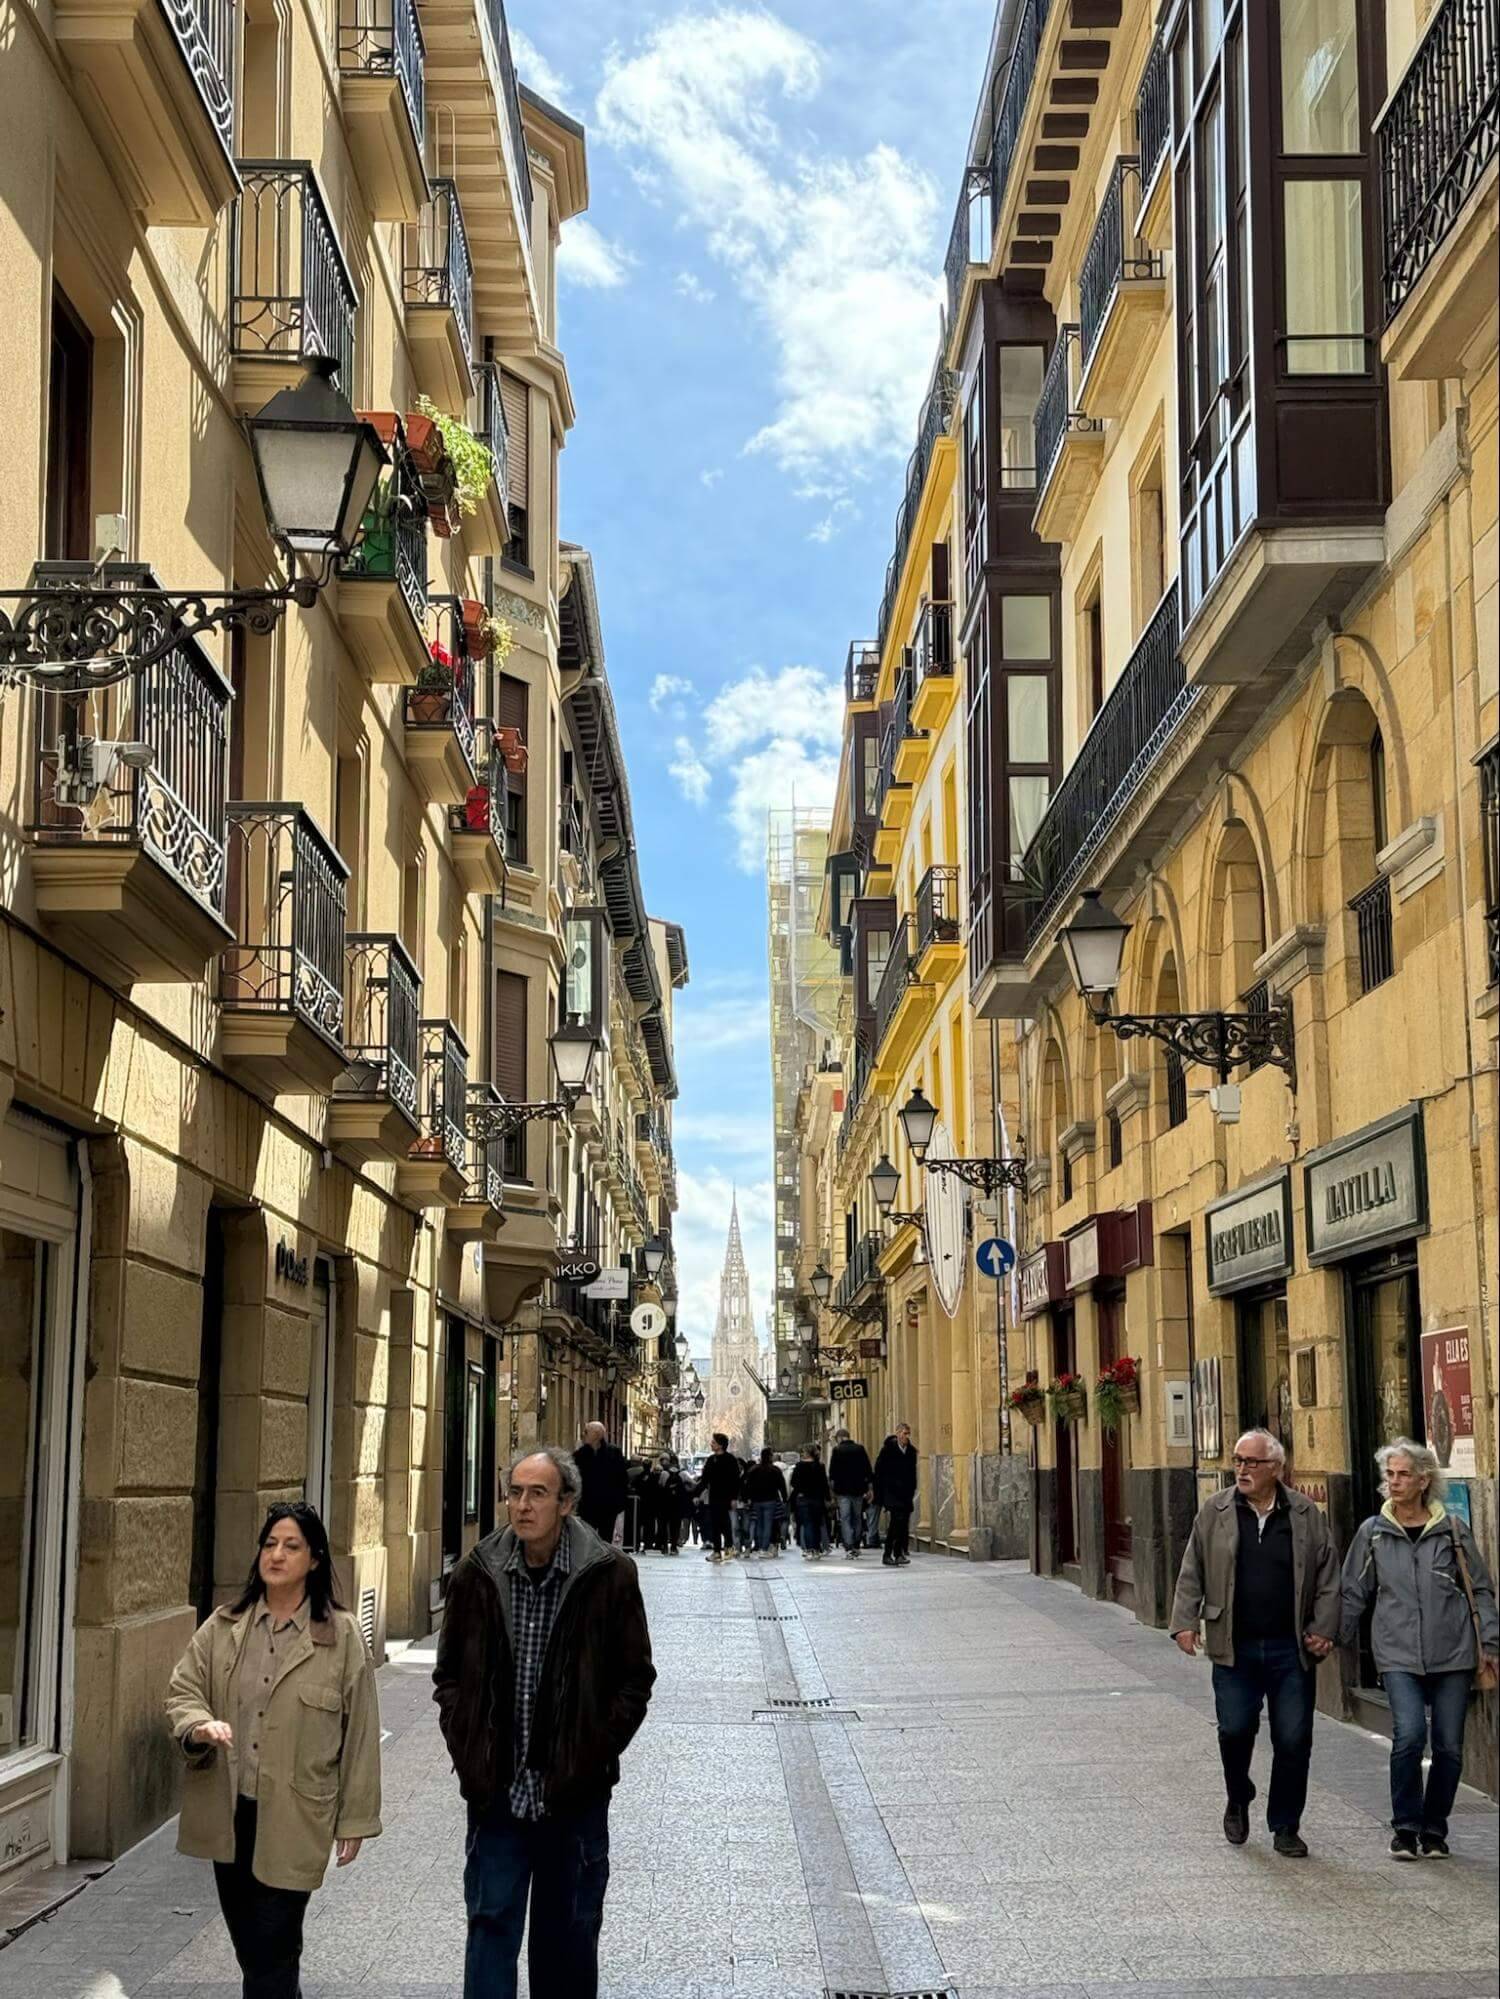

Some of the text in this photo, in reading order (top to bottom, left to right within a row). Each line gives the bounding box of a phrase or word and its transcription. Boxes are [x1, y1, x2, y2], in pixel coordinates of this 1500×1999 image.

[1326, 1161, 1397, 1225] MATILLA
[1214, 1209, 1282, 1265] PERFUMERIA
[1445, 1336, 1469, 1364] ELLA ES
[833, 1380, 864, 1400] ada
